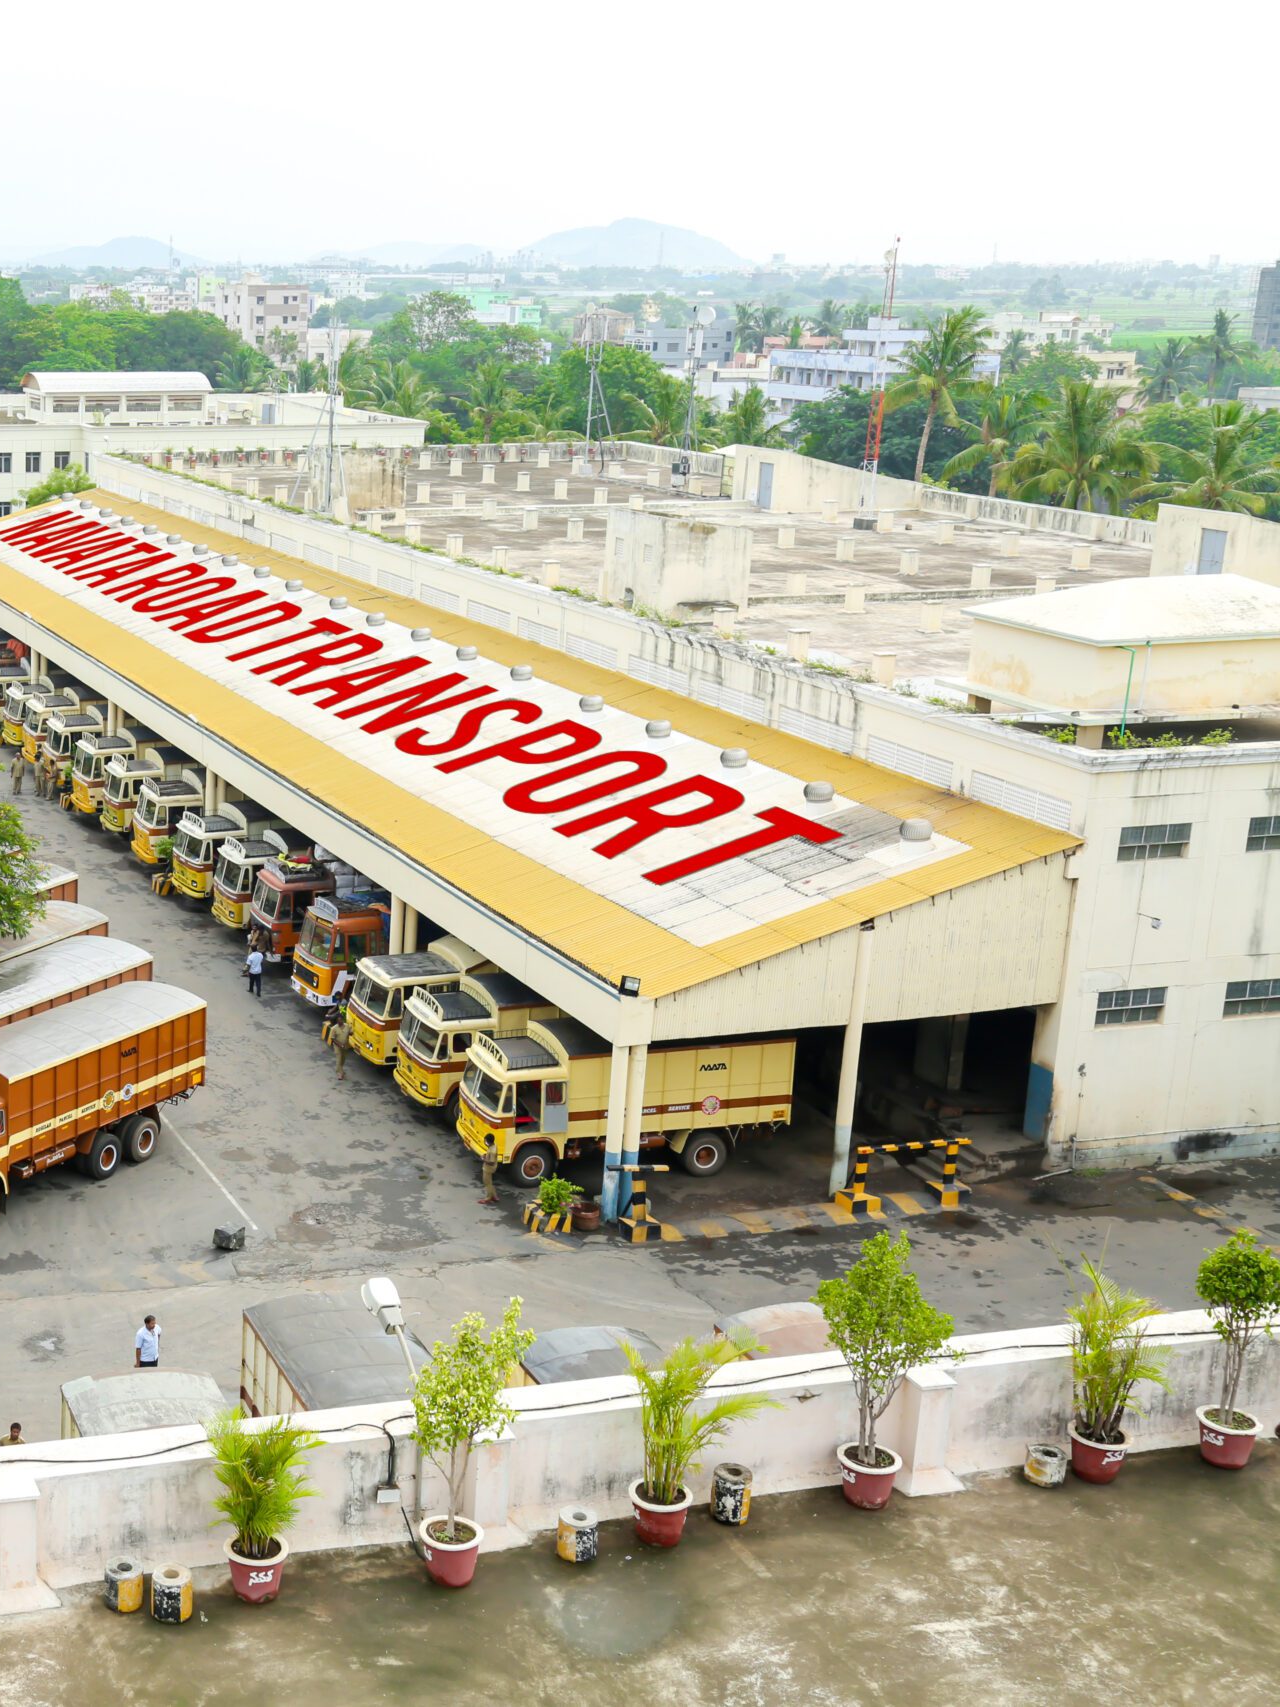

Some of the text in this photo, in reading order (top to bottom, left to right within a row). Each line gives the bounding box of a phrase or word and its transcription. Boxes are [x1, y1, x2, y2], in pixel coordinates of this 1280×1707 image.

[102, 562, 304, 644] ROAD
[226, 617, 843, 886] TRANSPORT
[184, 813, 203, 829] NAVATA
[416, 989, 439, 1016] NAVATA
[478, 1035, 503, 1065] NAVATA
[667, 1104, 691, 1112] SERVICE
